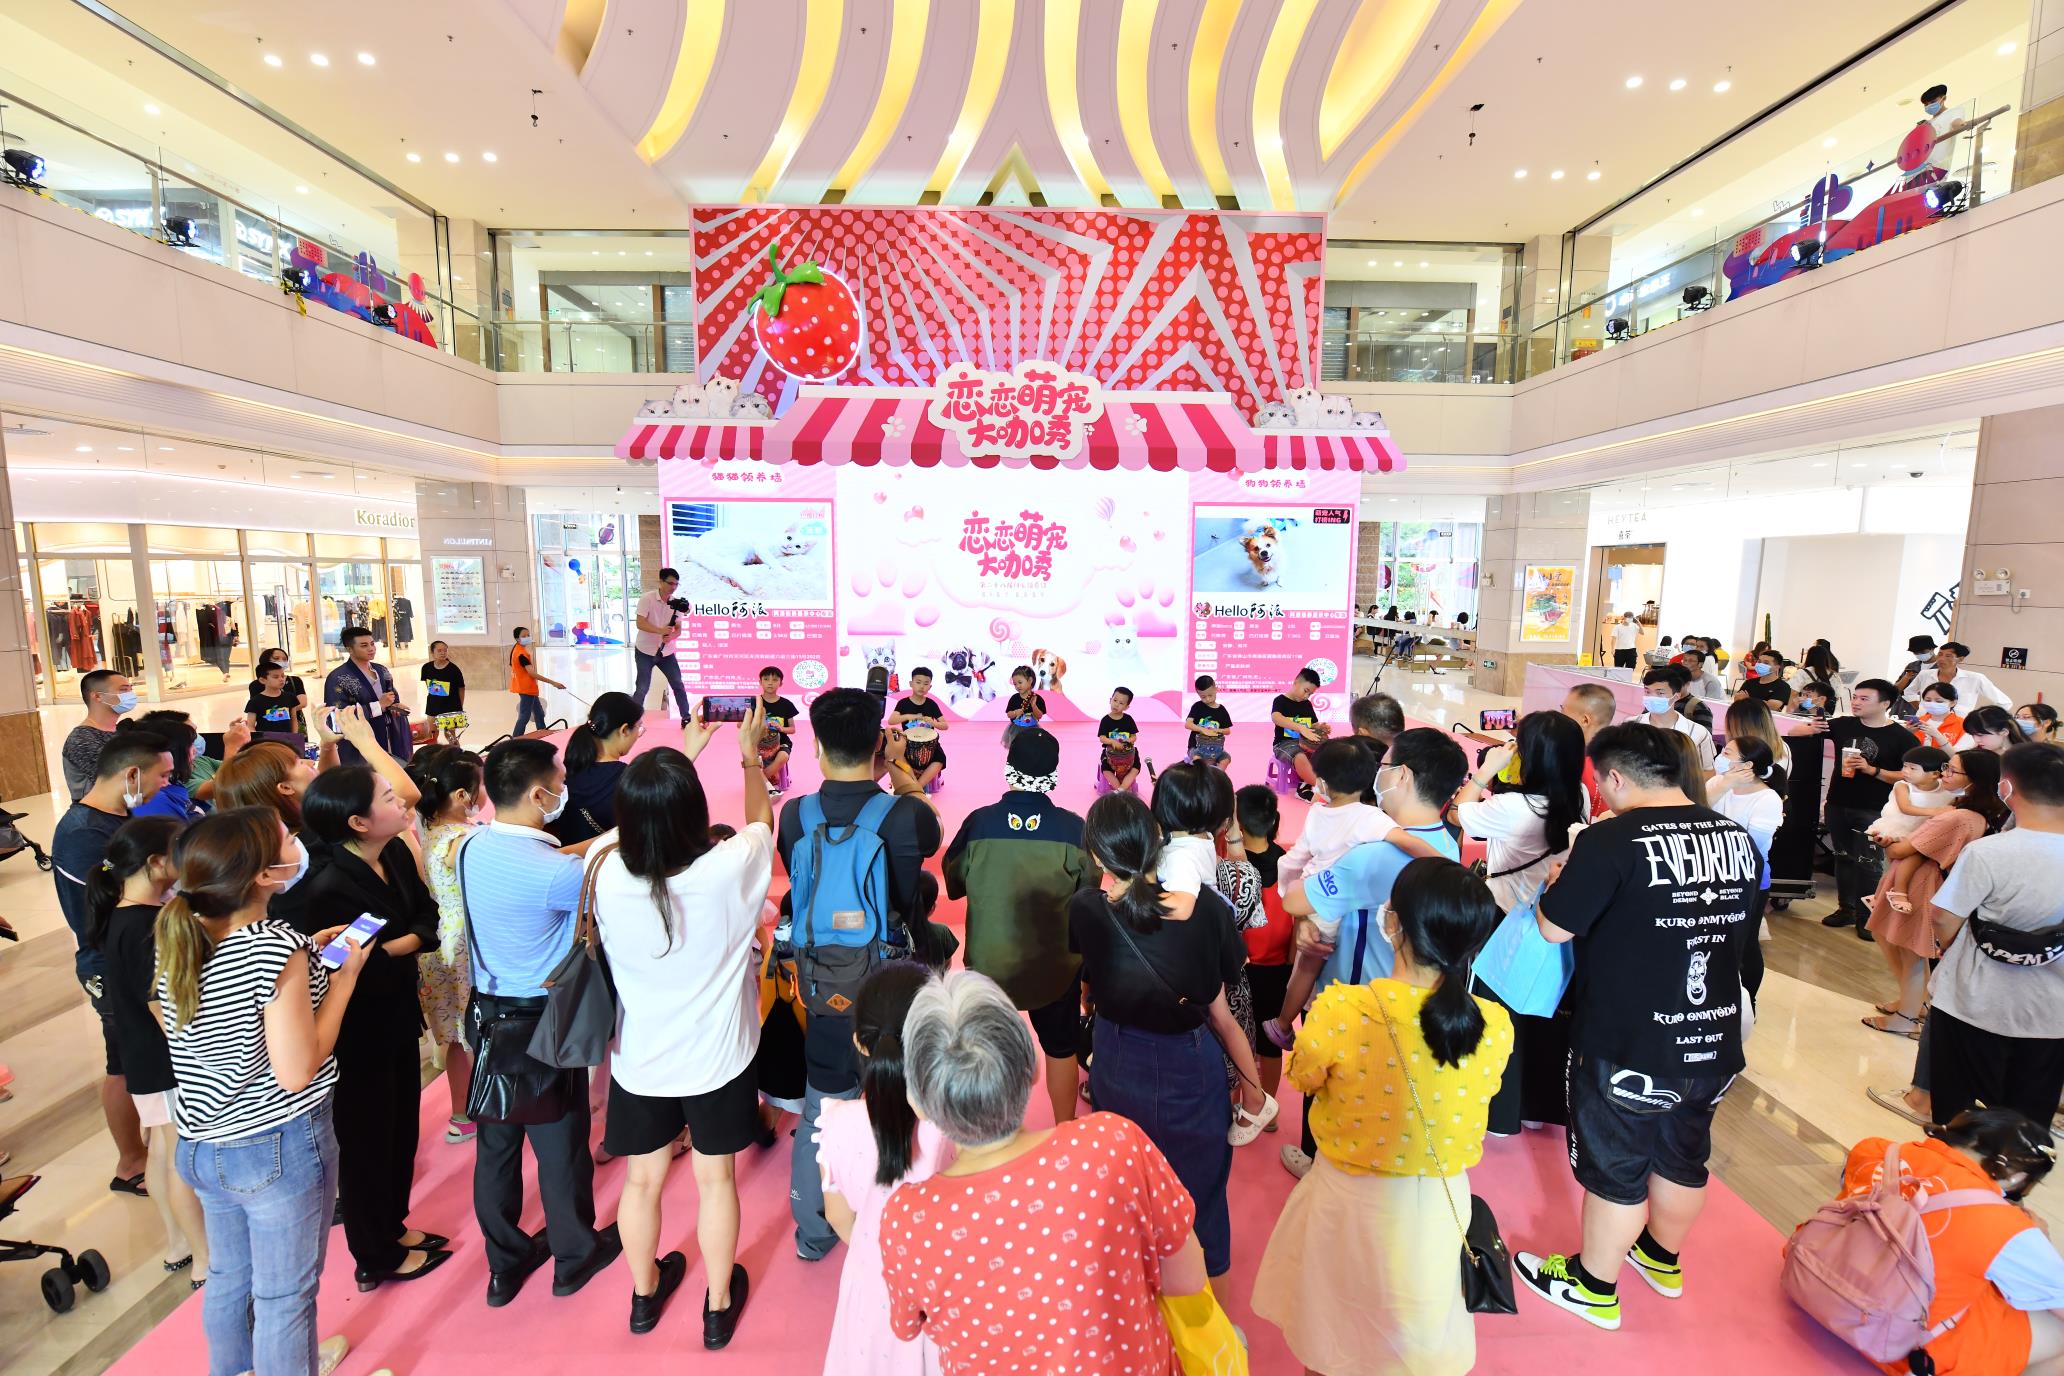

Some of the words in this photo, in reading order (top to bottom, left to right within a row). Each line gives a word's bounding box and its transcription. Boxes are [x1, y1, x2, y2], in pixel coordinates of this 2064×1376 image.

[941, 369, 1091, 422] 恋恋萌宠
[968, 415, 1071, 450] 大咖秀
[712, 472, 782, 482] 猫猫领养墙
[1245, 479, 1306, 488] 狗狗领养墙
[357, 510, 415, 527] Koradior
[1608, 512, 1647, 525] HEYTEA
[959, 509, 1067, 554] 恋恋萌宠
[977, 550, 1052, 581] 大咖秀
[1641, 822, 1678, 832] GATES
[1679, 823, 1692, 831] OF
[1693, 820, 1715, 829] THE
[1323, 869, 1339, 896] eko
[1672, 890, 1699, 898] BEYOND
[1655, 917, 1697, 928] KURO
[1711, 934, 1727, 943] IN
[1653, 1011, 1685, 1025] KURO
[1676, 1036, 1703, 1044] LAST
[1704, 1033, 1724, 1043] OUT
